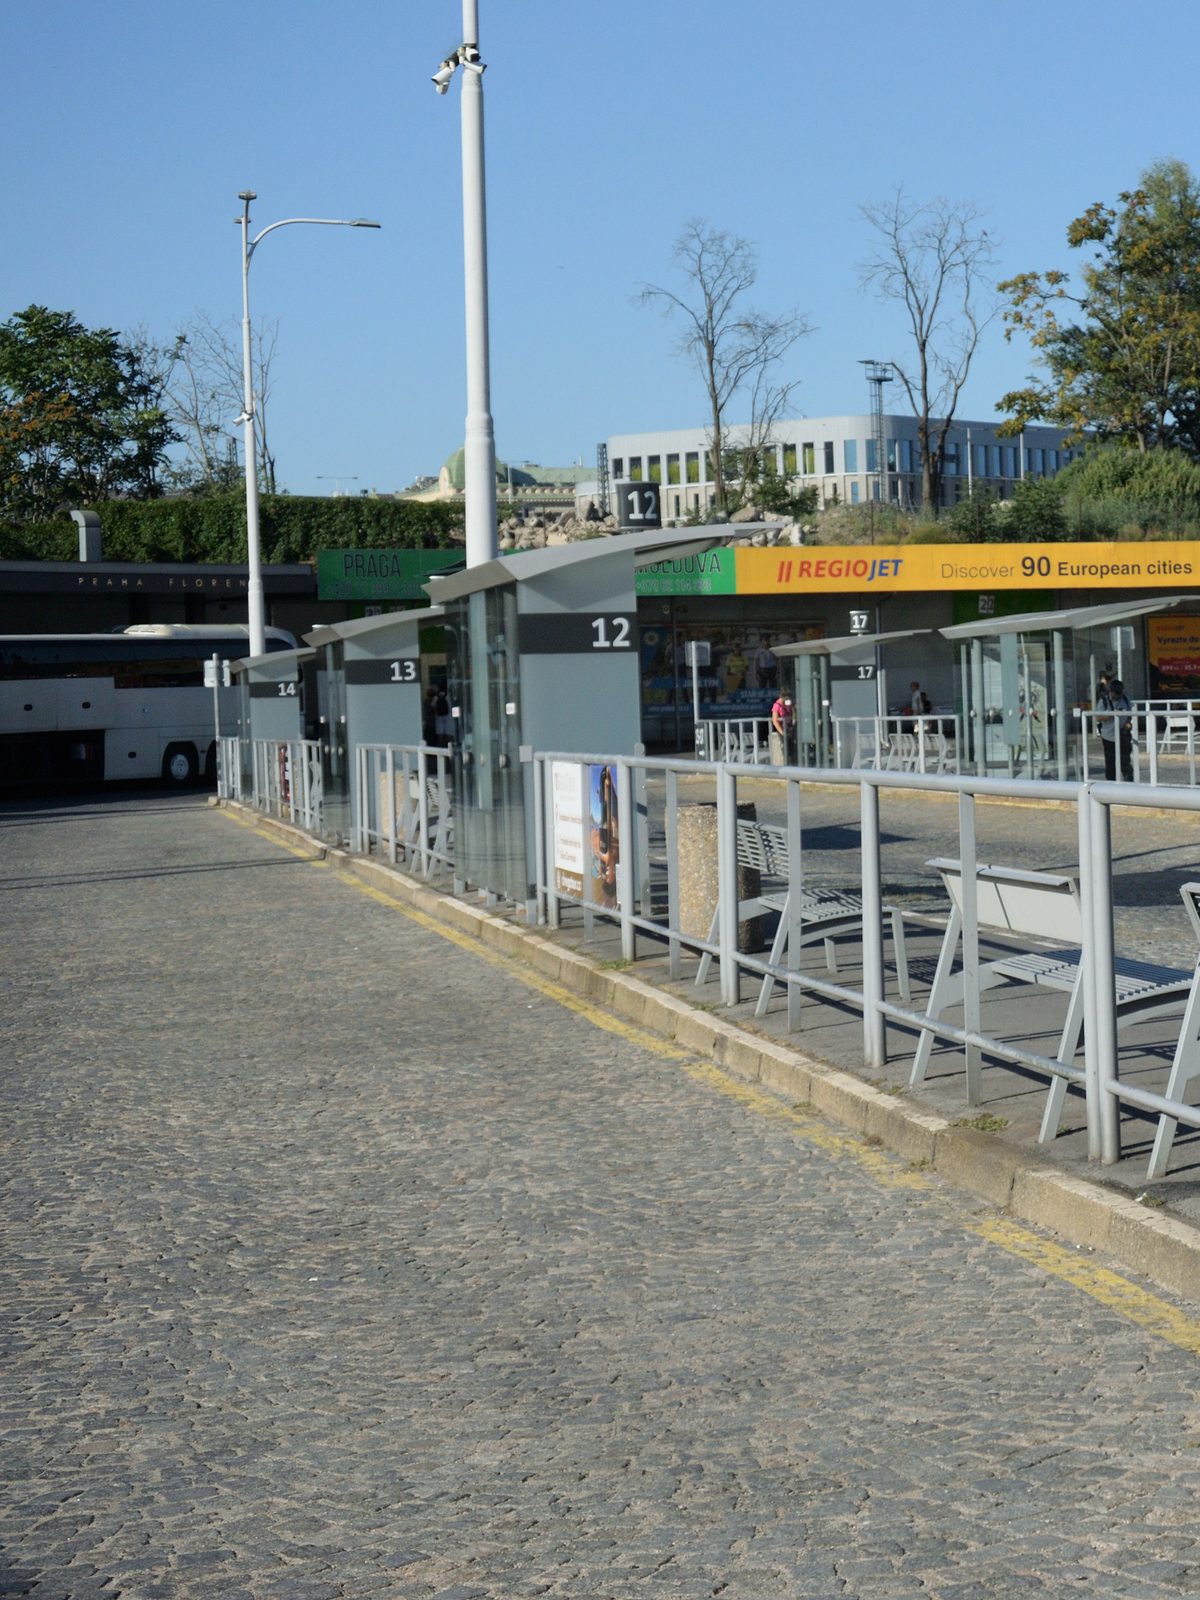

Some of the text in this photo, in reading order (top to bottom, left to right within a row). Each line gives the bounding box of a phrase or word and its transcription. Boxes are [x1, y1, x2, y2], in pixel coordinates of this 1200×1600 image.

[627, 490, 658, 520] 12
[343, 554, 401, 578] PRAGA
[798, 559, 903, 582] REGIOJET
[941, 556, 1193, 579] Discover 90 European cities
[78, 577, 246, 588] PRAHA FLOREN
[851, 614, 868, 629] 17
[591, 617, 631, 648] 12
[390, 661, 416, 681] 13
[857, 666, 873, 680] 17
[278, 682, 296, 696] 14
